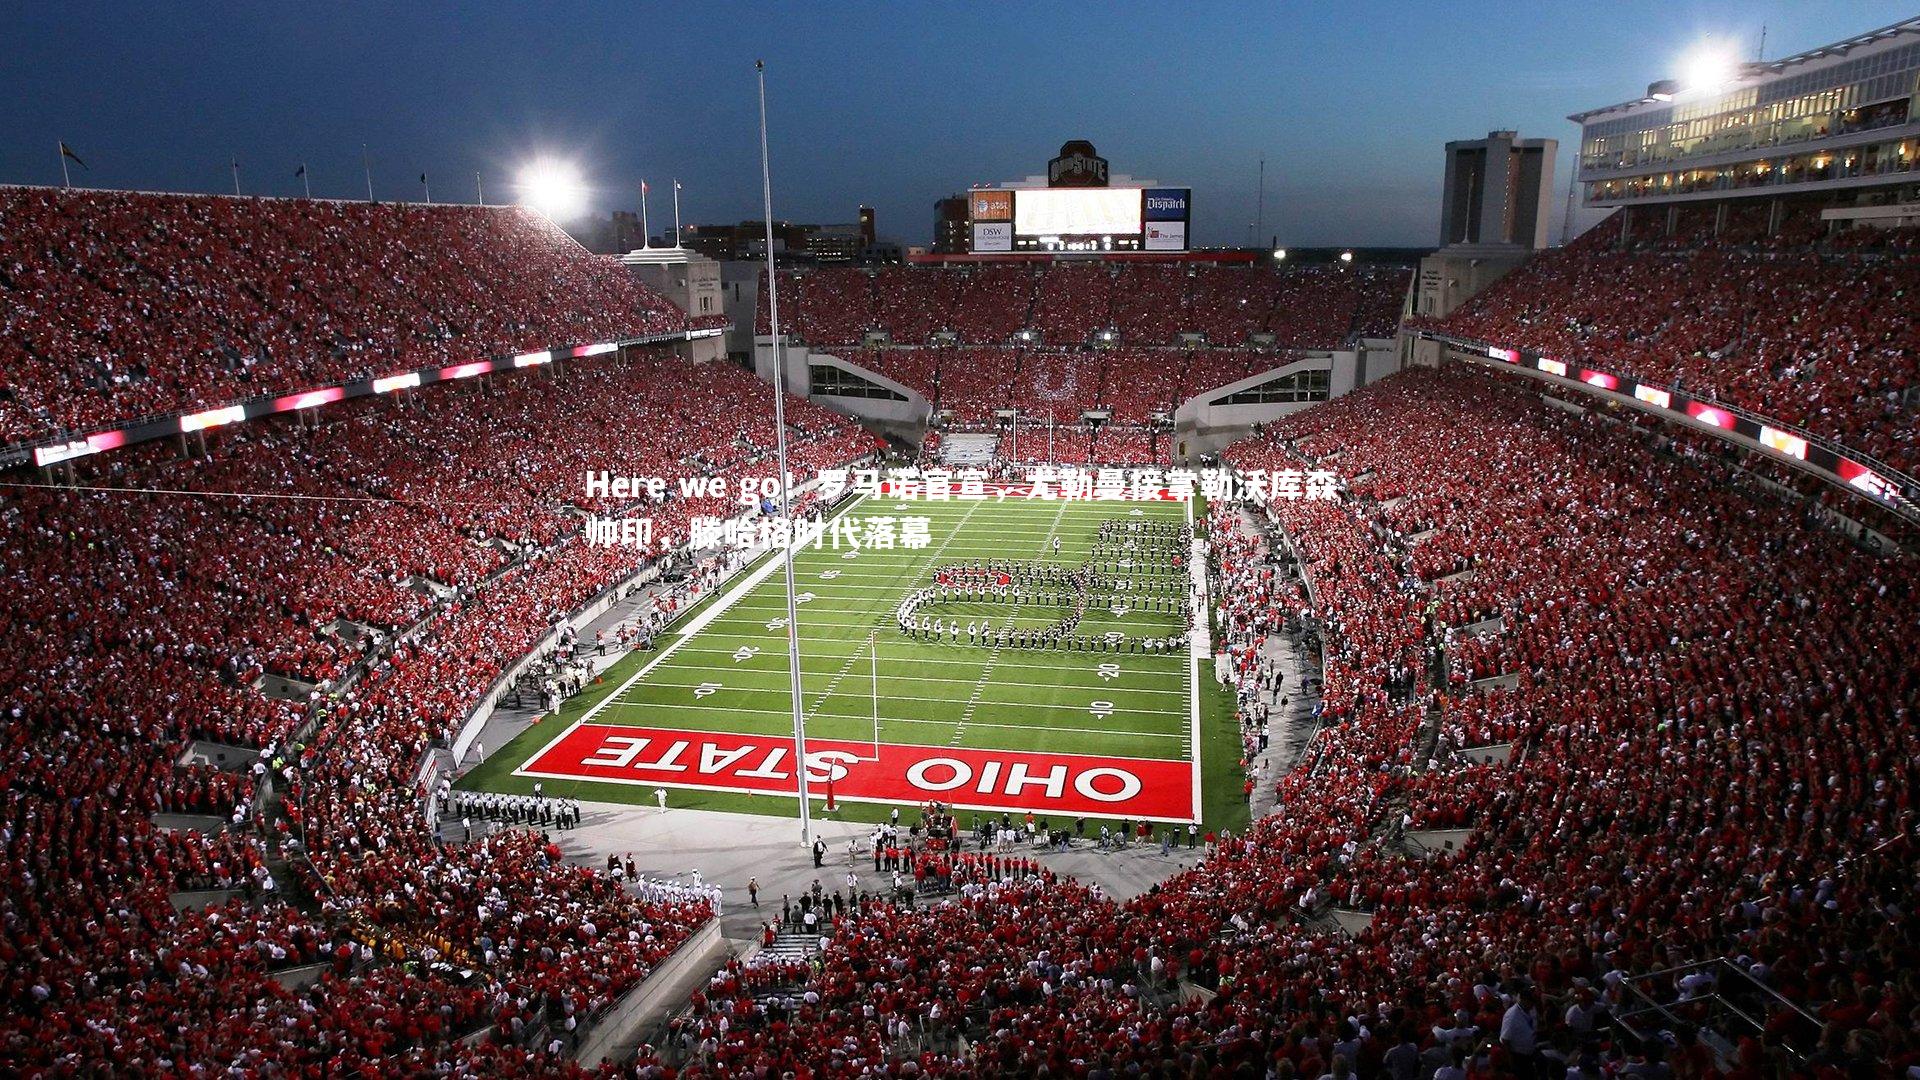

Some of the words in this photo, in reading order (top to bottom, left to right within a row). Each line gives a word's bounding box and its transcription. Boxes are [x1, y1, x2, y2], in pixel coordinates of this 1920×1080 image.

[1147, 197, 1186, 211] Dispatch
[983, 228, 1003, 236] DSW
[580, 735, 861, 784] STATE
[905, 756, 1143, 803] OHIO
